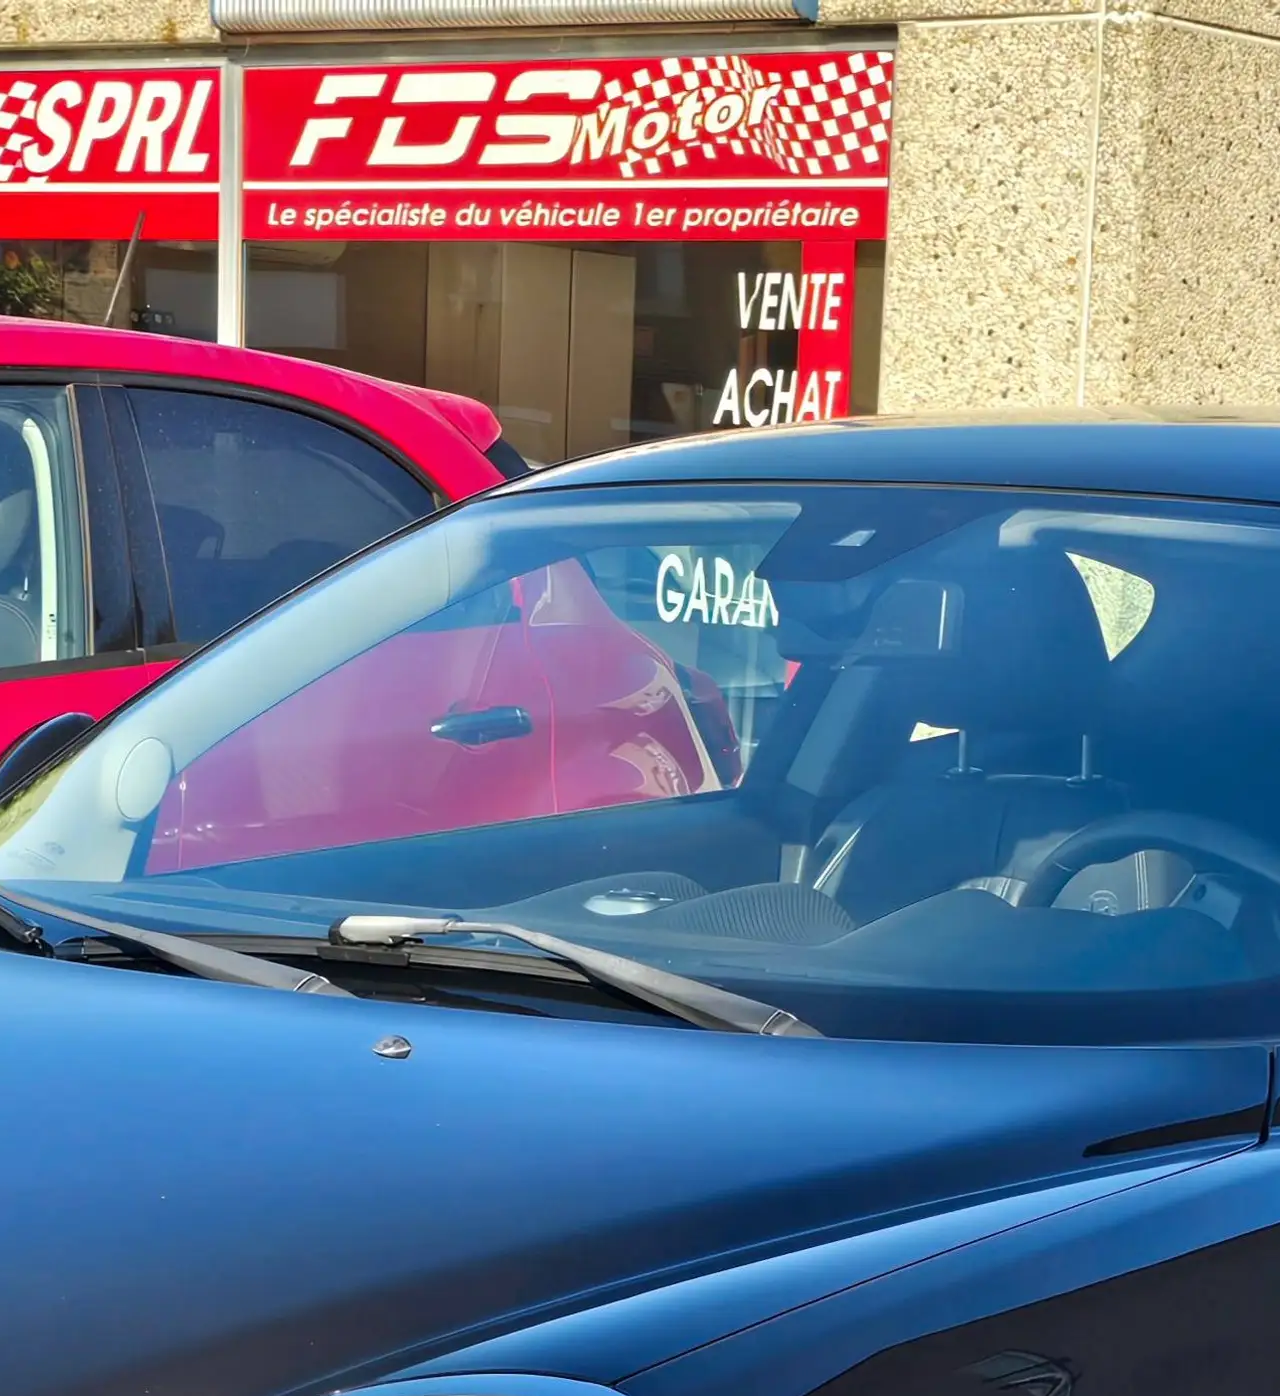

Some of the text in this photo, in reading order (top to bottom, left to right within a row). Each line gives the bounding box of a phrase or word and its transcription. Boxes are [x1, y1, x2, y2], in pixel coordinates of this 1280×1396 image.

[22, 79, 213, 173] SPRL
[290, 70, 782, 166] FDS Motor
[268, 199, 859, 232] Le spécialiste du véhicule 1er propriétaire
[737, 271, 845, 331] VENTE
[712, 367, 842, 428] ACHAT
